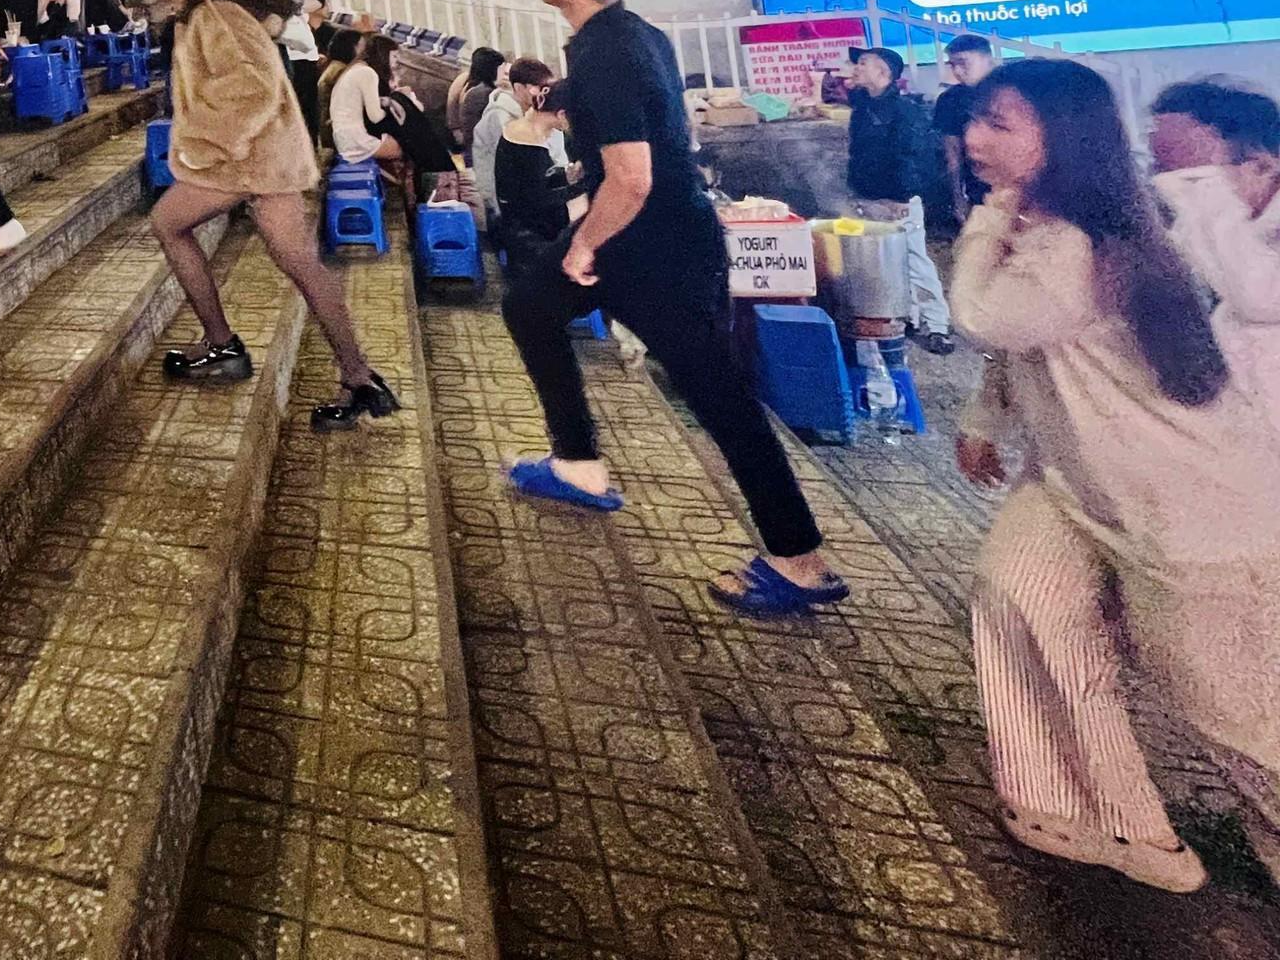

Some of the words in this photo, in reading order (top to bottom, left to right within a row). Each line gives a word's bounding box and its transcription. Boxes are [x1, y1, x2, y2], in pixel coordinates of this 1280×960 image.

[965, 4, 1020, 23] thuốc
[1023, 3, 1061, 20] tiện
[1065, 0, 1089, 16] lợi
[738, 236, 778, 251] YOGURT
[788, 256, 808, 271] MAI
